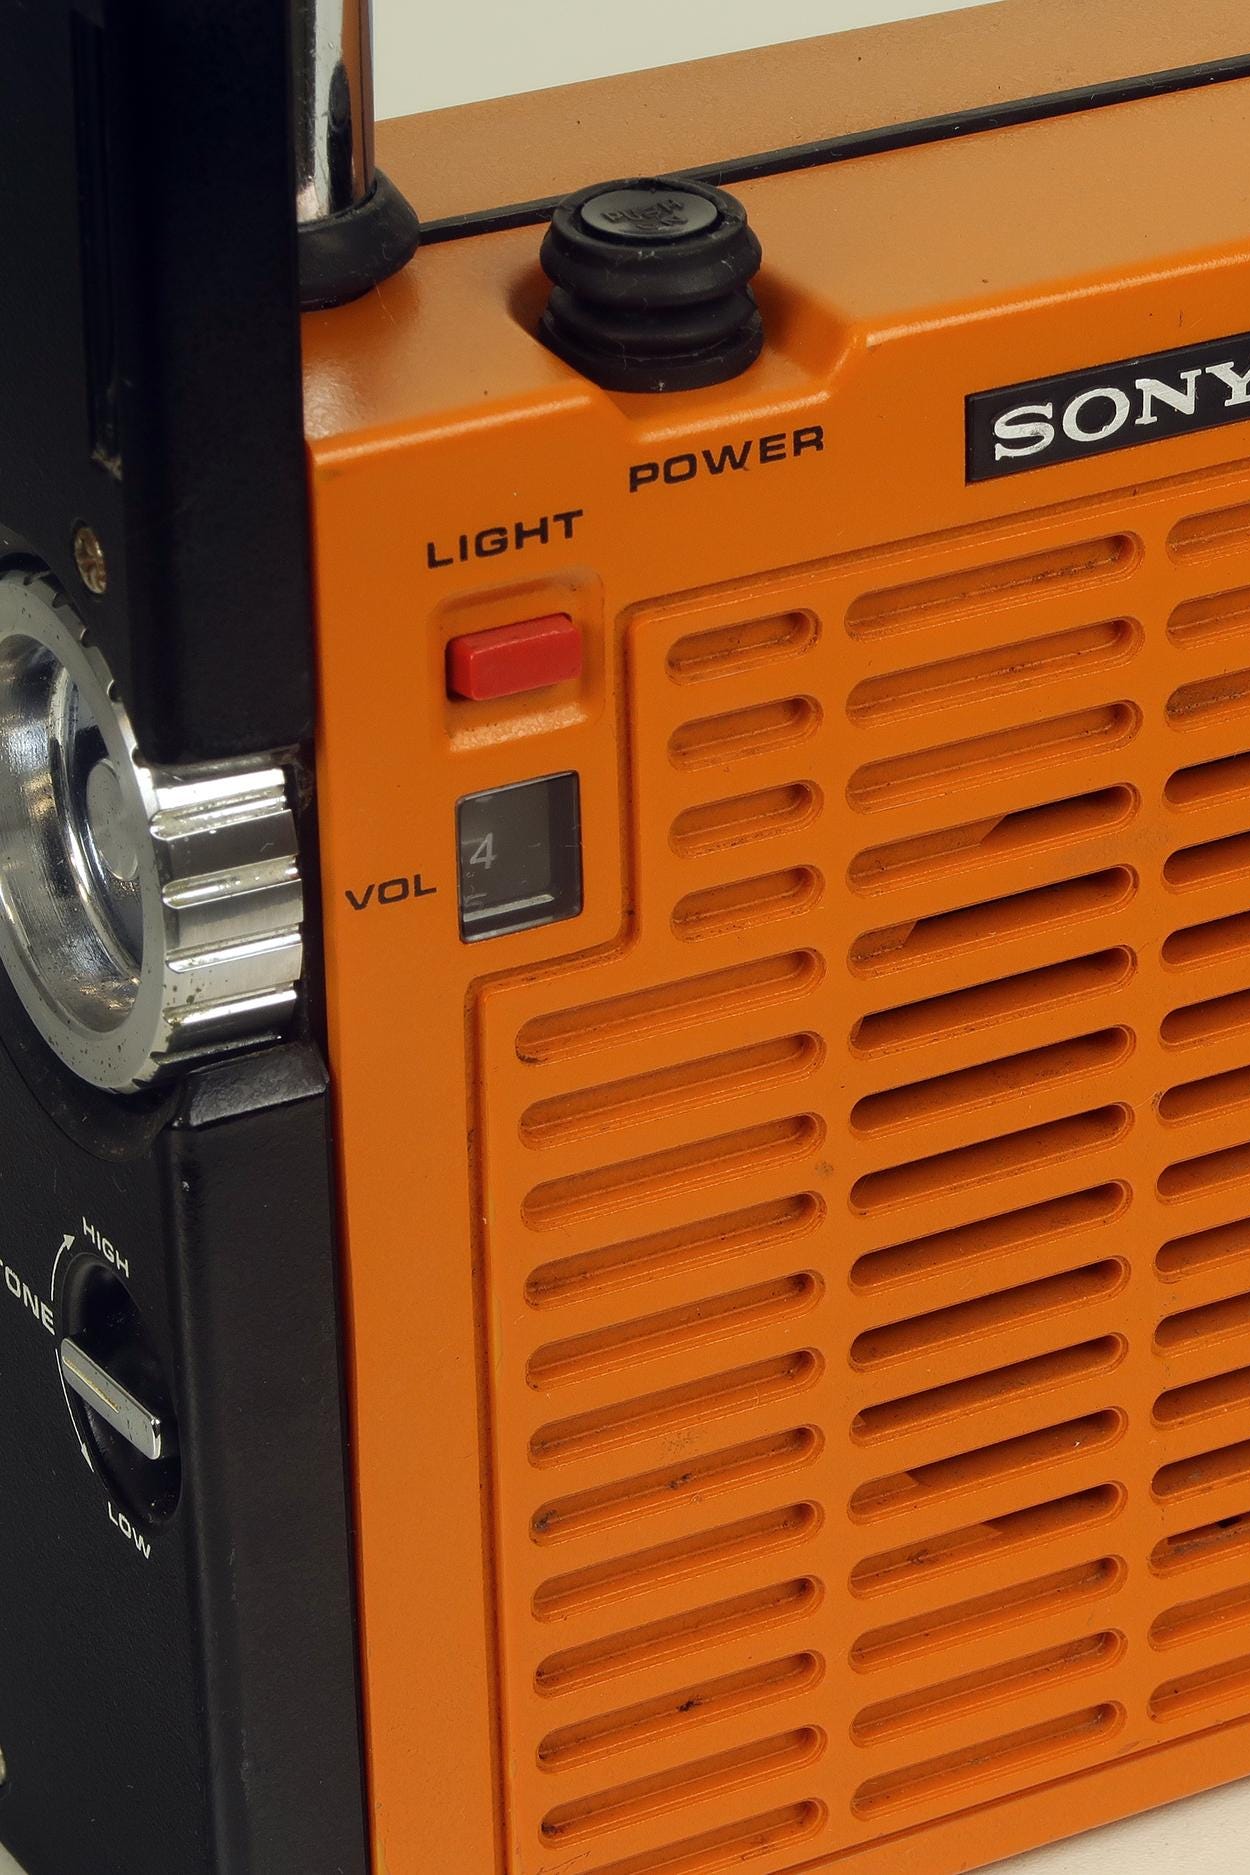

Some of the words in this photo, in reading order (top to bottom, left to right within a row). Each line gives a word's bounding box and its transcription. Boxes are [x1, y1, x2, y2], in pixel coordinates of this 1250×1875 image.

[628, 424, 826, 493] POWER
[426, 508, 584, 569] LIGHT
[469, 831, 497, 870] 4
[344, 873, 438, 911] VOL
[81, 1215, 130, 1279] HIGH
[0, 1257, 56, 1336] ONE
[107, 1500, 151, 1560] LOW
